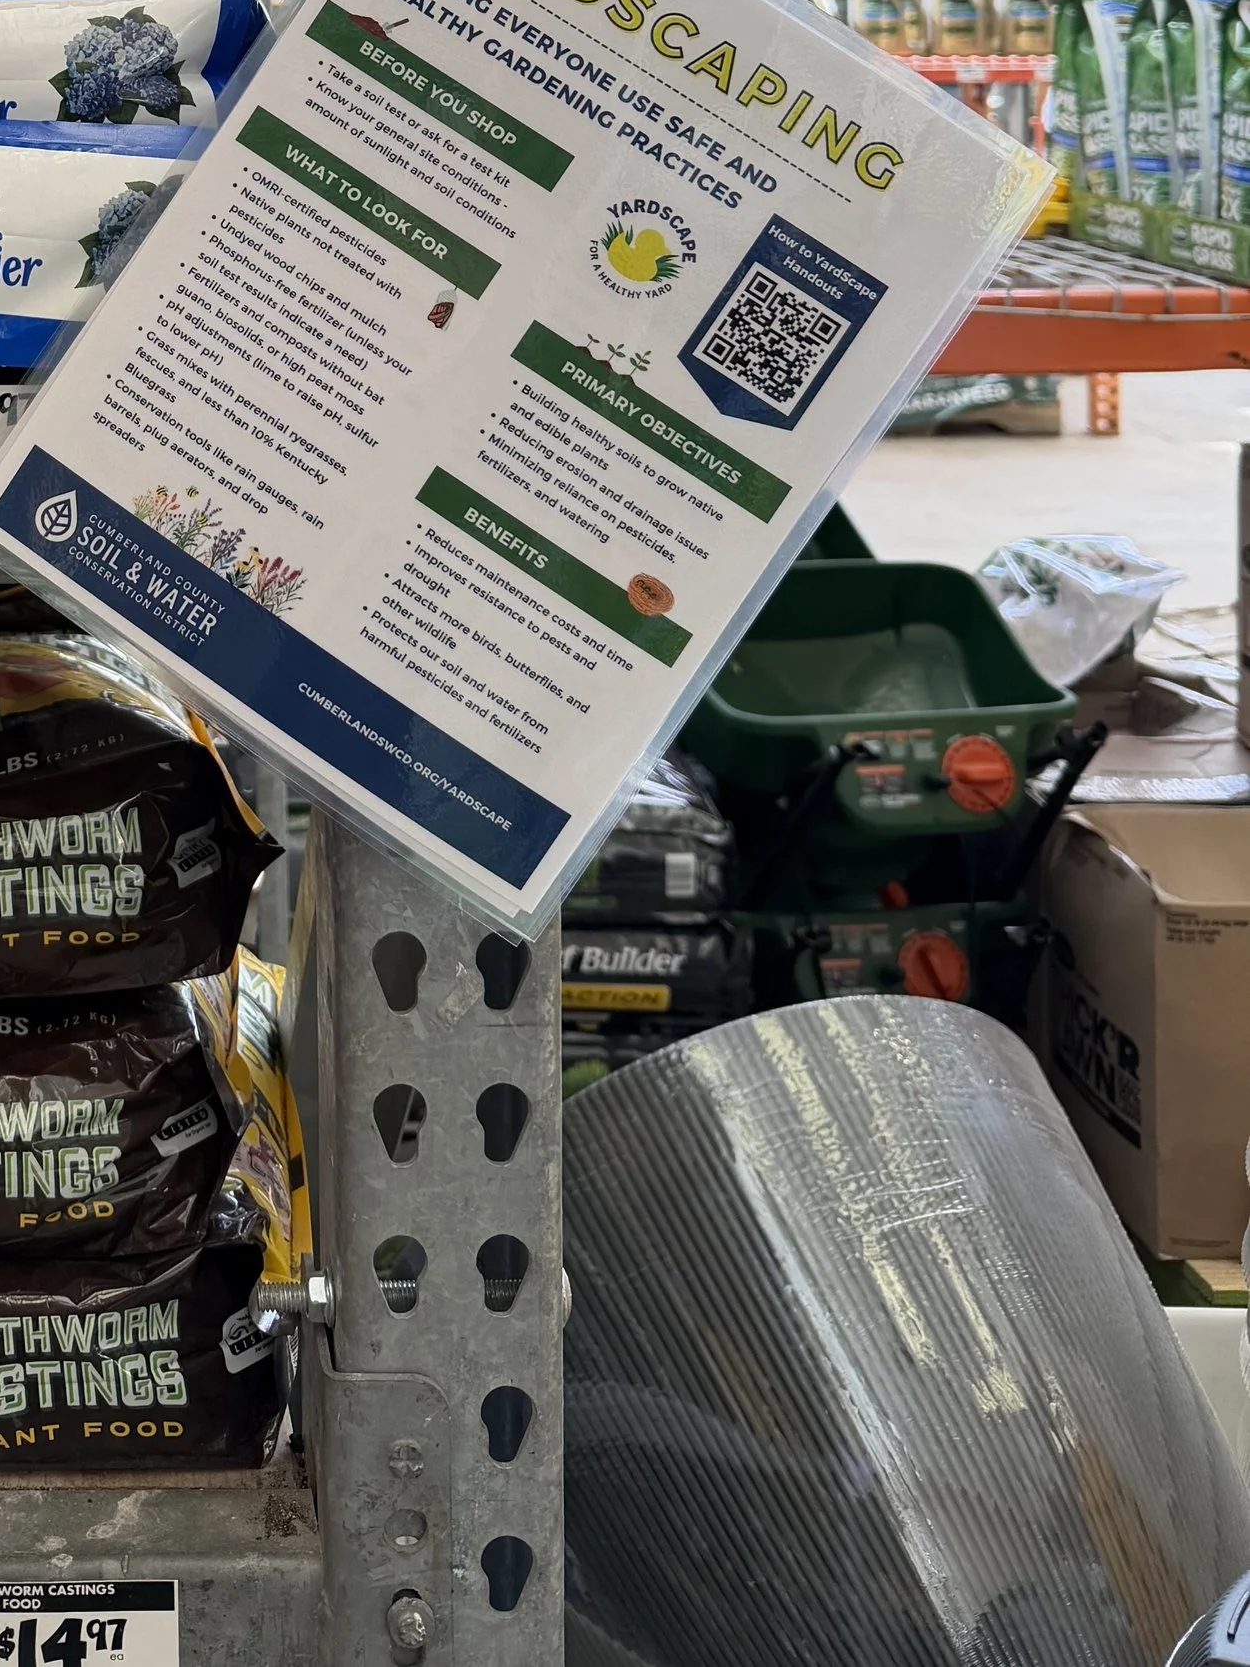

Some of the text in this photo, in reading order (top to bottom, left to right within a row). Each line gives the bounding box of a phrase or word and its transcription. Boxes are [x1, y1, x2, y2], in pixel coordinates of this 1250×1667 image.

[358, 39, 517, 145] BEFORE YOU SHOP
[482, 37, 616, 129] GARDENING
[615, 120, 743, 209] PRACTICES
[492, 5, 617, 93] EVERYONE
[616, 82, 666, 123] USE
[663, 114, 726, 162] SAFE
[723, 155, 777, 193] AND
[250, 170, 387, 266] OMRI-certified pesticides
[284, 143, 448, 260] WHAT TO LOOK FOR
[607, 199, 697, 263] YARDSCAPE
[219, 217, 387, 337] Undyed wood chips and mulch
[767, 223, 877, 300] How to YardScape
[782, 254, 844, 300] Handouts
[91, 410, 146, 452] spreaders
[123, 361, 177, 404] Bluegrass
[560, 360, 742, 484] PRIMARY OBJECTIVES
[76, 525, 217, 636] SOIL & WATER
[87, 513, 226, 614] CUMBERLAND COUNTY
[462, 506, 549, 569] BENEFITS
[67, 545, 205, 646] CONSERVATION DISTRICT
[423, 527, 634, 672] Reduces maintenance costs and time
[297, 681, 512, 832] CUMBERLANDSWCD.ORG/YARDSCAPE
[42, 930, 140, 946] FOOD
[84, 1420, 184, 1439] FOOD
[3, 1598, 41, 1609] FOOD
[49, 1584, 115, 1595] CASTINGS
